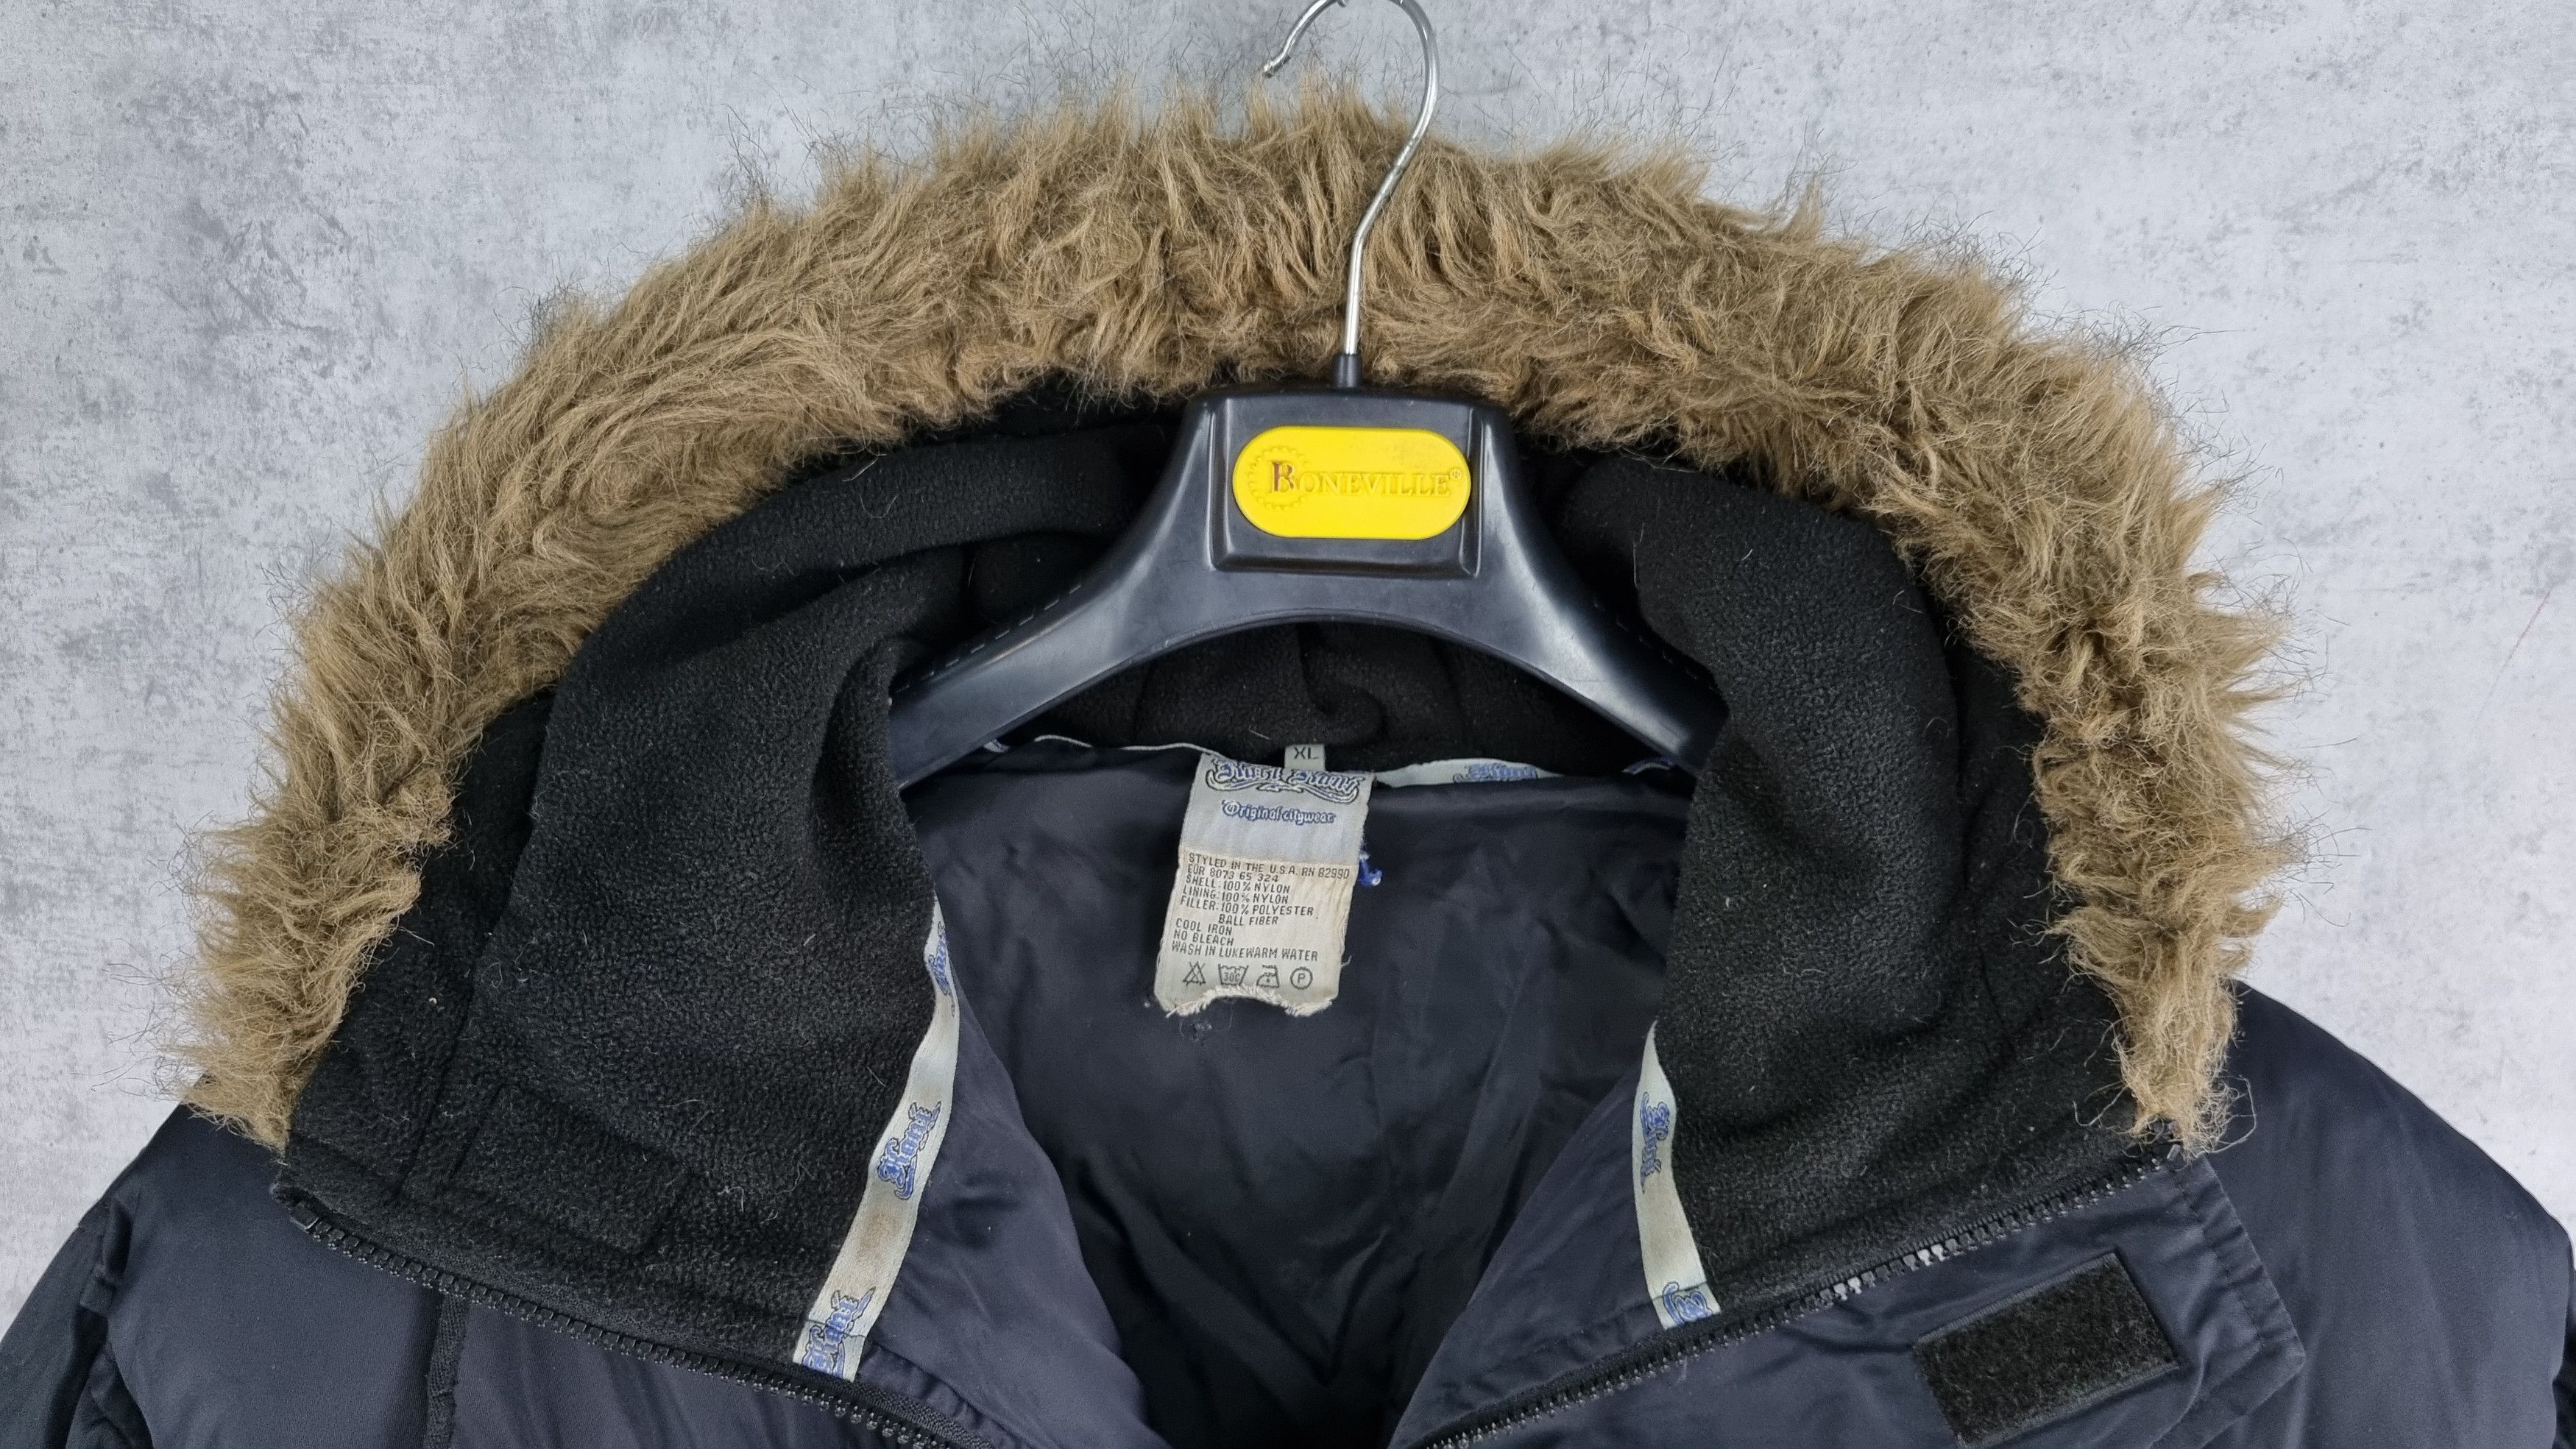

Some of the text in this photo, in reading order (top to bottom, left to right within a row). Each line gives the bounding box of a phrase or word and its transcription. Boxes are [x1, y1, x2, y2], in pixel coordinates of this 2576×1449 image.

[1293, 747, 1320, 759] XL
[1221, 800, 1337, 826] Original citywear
[1187, 863, 1278, 882] EUR 8073 65 324
[1189, 852, 1350, 879] STYLED IN THE U.S.A. RN 82990
[1254, 882, 1290, 893] NYLON
[1253, 893, 1289, 904] NYLON
[1252, 904, 1314, 916] POLYESTER
[1175, 918, 1233, 936] COOL IRON
[1218, 913, 1279, 926] BALL FIBER
[1173, 929, 1234, 946] NO BLEACH
[1172, 940, 1318, 961] WASH IN LUKEWARM WATER
[1298, 972, 1306, 983] P
